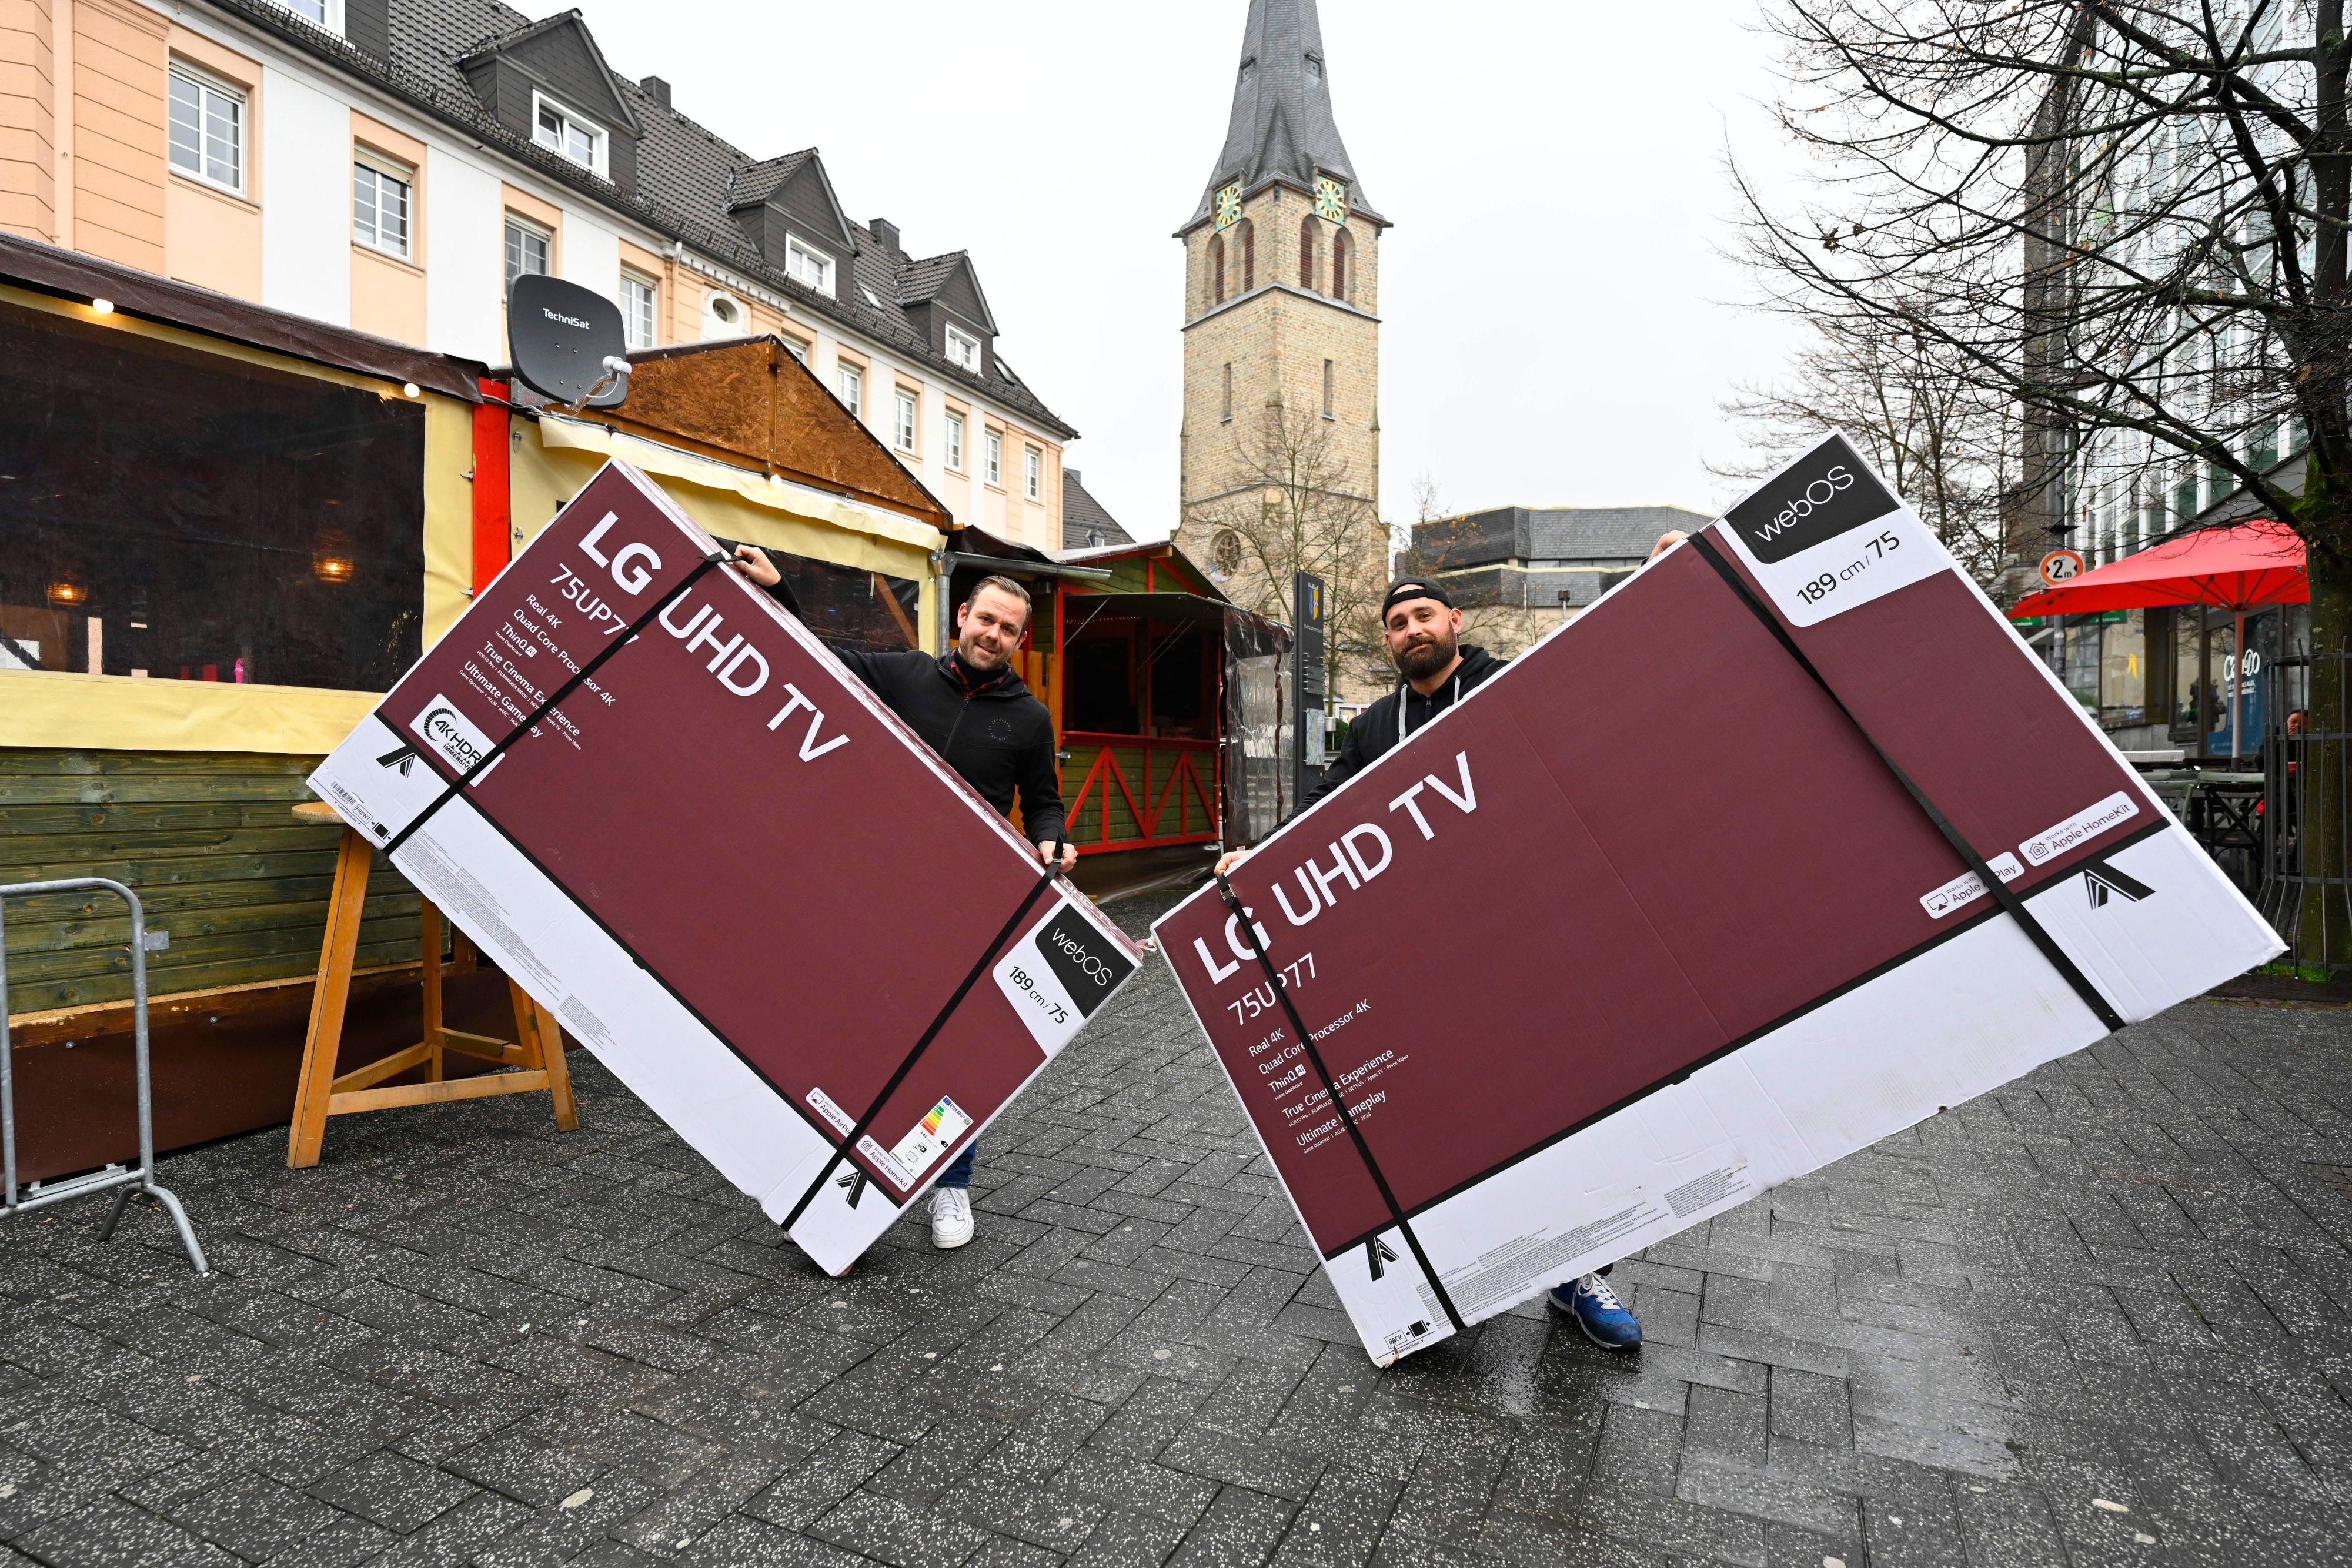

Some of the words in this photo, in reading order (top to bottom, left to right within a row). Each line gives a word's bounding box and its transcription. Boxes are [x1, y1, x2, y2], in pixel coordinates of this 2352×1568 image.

[543, 307, 590, 330] TechniSat
[1755, 466, 1854, 542] webOS
[1796, 573, 1837, 605] 189
[1840, 559, 1865, 581] cm
[1865, 530, 1900, 559] 75
[2053, 559, 2062, 578] 2
[526, 594, 548, 617] Real
[546, 613, 562, 629] 4K
[495, 630, 505, 641] Home
[505, 638, 522, 657] Dashboard
[502, 622, 526, 650] ThinQ
[578, 510, 662, 596] LG
[658, 586, 770, 696] UHD
[767, 683, 851, 763] TV
[514, 609, 539, 634] Quad
[537, 631, 559, 654] Core
[600, 692, 616, 707] 4K
[459, 670, 469, 680] Game
[469, 677, 485, 694] Optimizer
[487, 696, 497, 706] ALLM
[499, 708, 508, 717] eARC
[465, 660, 501, 698] Ultimate
[502, 696, 543, 738] Gameay
[477, 650, 489, 663] HDR10
[497, 670, 517, 690] FILMMAKER
[517, 688, 528, 700] MODE
[546, 714, 556, 727] Apple
[562, 730, 573, 741] Prime
[572, 739, 582, 750] Video
[482, 641, 503, 663] True
[502, 660, 534, 694] Cinema
[533, 690, 580, 736] Exerience
[434, 721, 455, 738] 4K
[449, 733, 482, 764] HDR
[443, 744, 473, 771] IMMERSIVE
[354, 805, 370, 821] FRONT
[2051, 827, 2083, 850] Apple
[2083, 803, 2131, 834] HomeKit
[2044, 831, 2063, 842] Works
[2063, 822, 2077, 833] with
[1193, 907, 1271, 985] LG
[1271, 823, 1393, 927] UHD
[1389, 750, 1478, 841] TV
[1946, 884, 1963, 895] Works
[1962, 875, 1976, 887] with
[1063, 880, 1094, 910] UHD
[1098, 912, 1117, 930] TV
[1952, 884, 1981, 903] Apple
[1052, 928, 1112, 986] webOS
[1009, 966, 1034, 991] 189
[1030, 991, 1045, 1006] cm
[1048, 1002, 1068, 1024] 75
[1249, 1038, 1270, 1057] Real
[1271, 1028, 1285, 1043] 4K
[1259, 1056, 1284, 1075] Quad
[1284, 1041, 1305, 1059] Core
[1308, 1009, 1354, 1041] Processor
[1355, 998, 1371, 1014] 4K
[1268, 1070, 1298, 1093] ThinQ
[1275, 1090, 1288, 1101] Home
[1287, 1081, 1303, 1094] Dashboard
[1282, 1102, 1305, 1119] True
[1339, 1049, 1394, 1086] Experience
[1289, 1117, 1302, 1127] HDR10
[1311, 1098, 1333, 1115] FILMMAKER
[1348, 1080, 1364, 1092] NETFLIX
[1386, 1061, 1398, 1071] Prime
[1396, 1054, 1409, 1064] Video
[820, 1104, 837, 1121] Apple
[834, 1118, 852, 1135] AirPla
[824, 1100, 835, 1111] Works
[833, 1108, 841, 1116] with
[949, 1103, 964, 1118] ENERG
[1296, 1118, 1338, 1146] Ultimate
[1313, 1136, 1331, 1148] Optimizer
[1334, 1127, 1345, 1137] ALLM
[869, 1151, 887, 1169] Apple
[885, 1163, 908, 1188] HomeKit
[874, 1147, 884, 1158] Works
